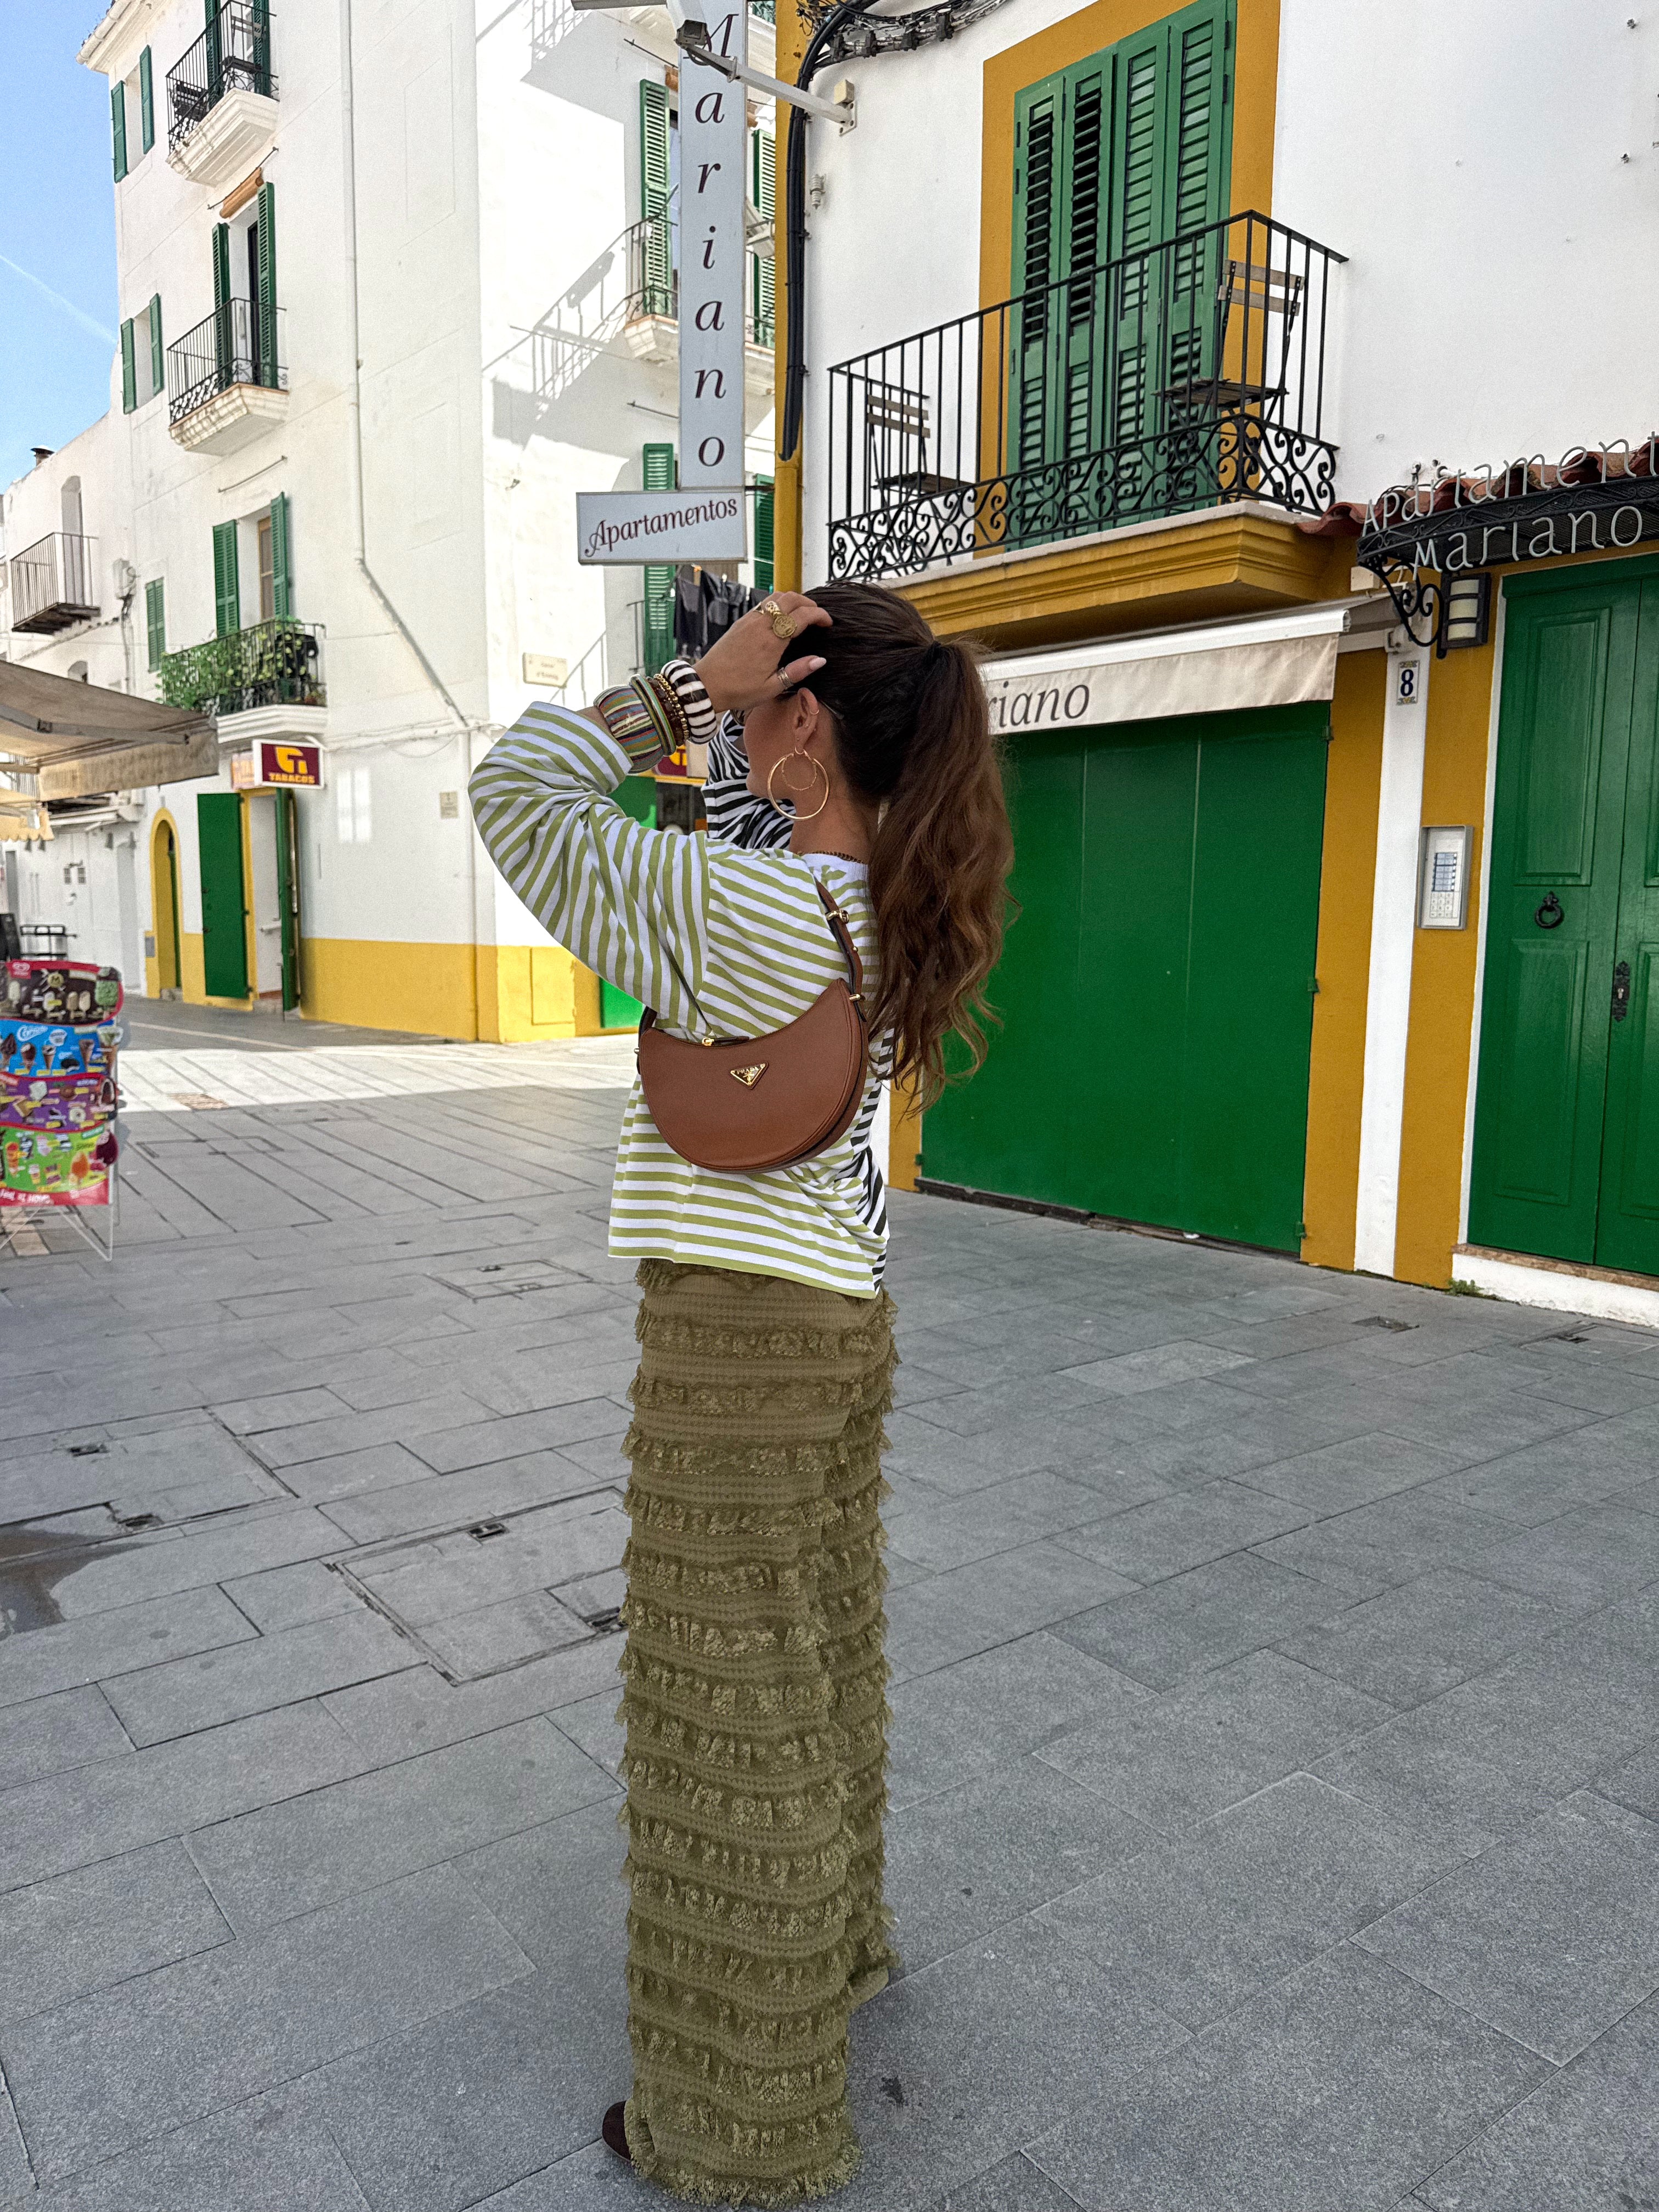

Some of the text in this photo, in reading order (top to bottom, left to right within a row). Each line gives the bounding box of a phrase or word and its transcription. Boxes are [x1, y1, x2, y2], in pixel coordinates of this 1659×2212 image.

[584, 498, 737, 557] Apartamentos
[1412, 505, 1643, 582] Mariano
[1400, 669, 1414, 697] 8
[269, 772, 315, 785] TABACOS
[737, 1066, 759, 1075] PRADA
